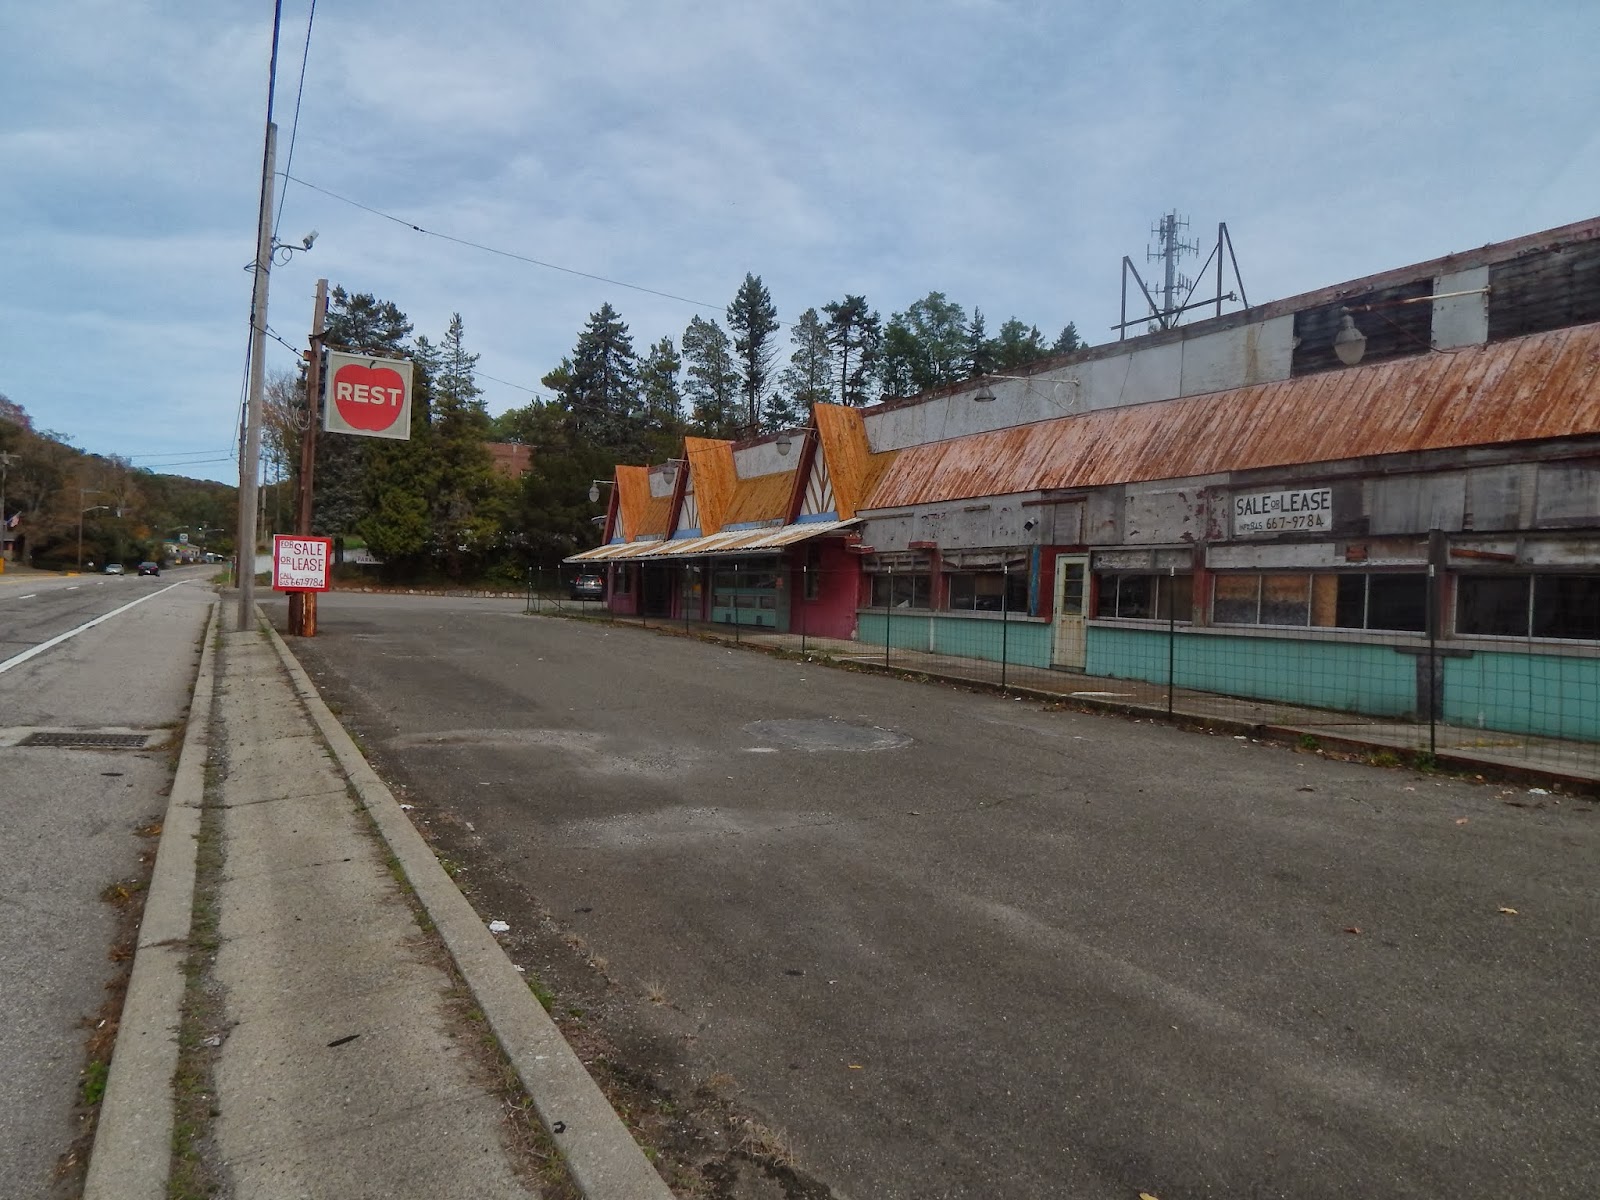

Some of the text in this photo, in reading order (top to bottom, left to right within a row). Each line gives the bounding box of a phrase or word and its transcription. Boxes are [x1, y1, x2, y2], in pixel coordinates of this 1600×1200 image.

[337, 382, 402, 406] REST
[1236, 492, 1330, 516] SALE OR LEASE
[1266, 514, 1324, 530] 667-9784
[280, 540, 322, 556] FOR SALE
[292, 558, 323, 572] LEASE
